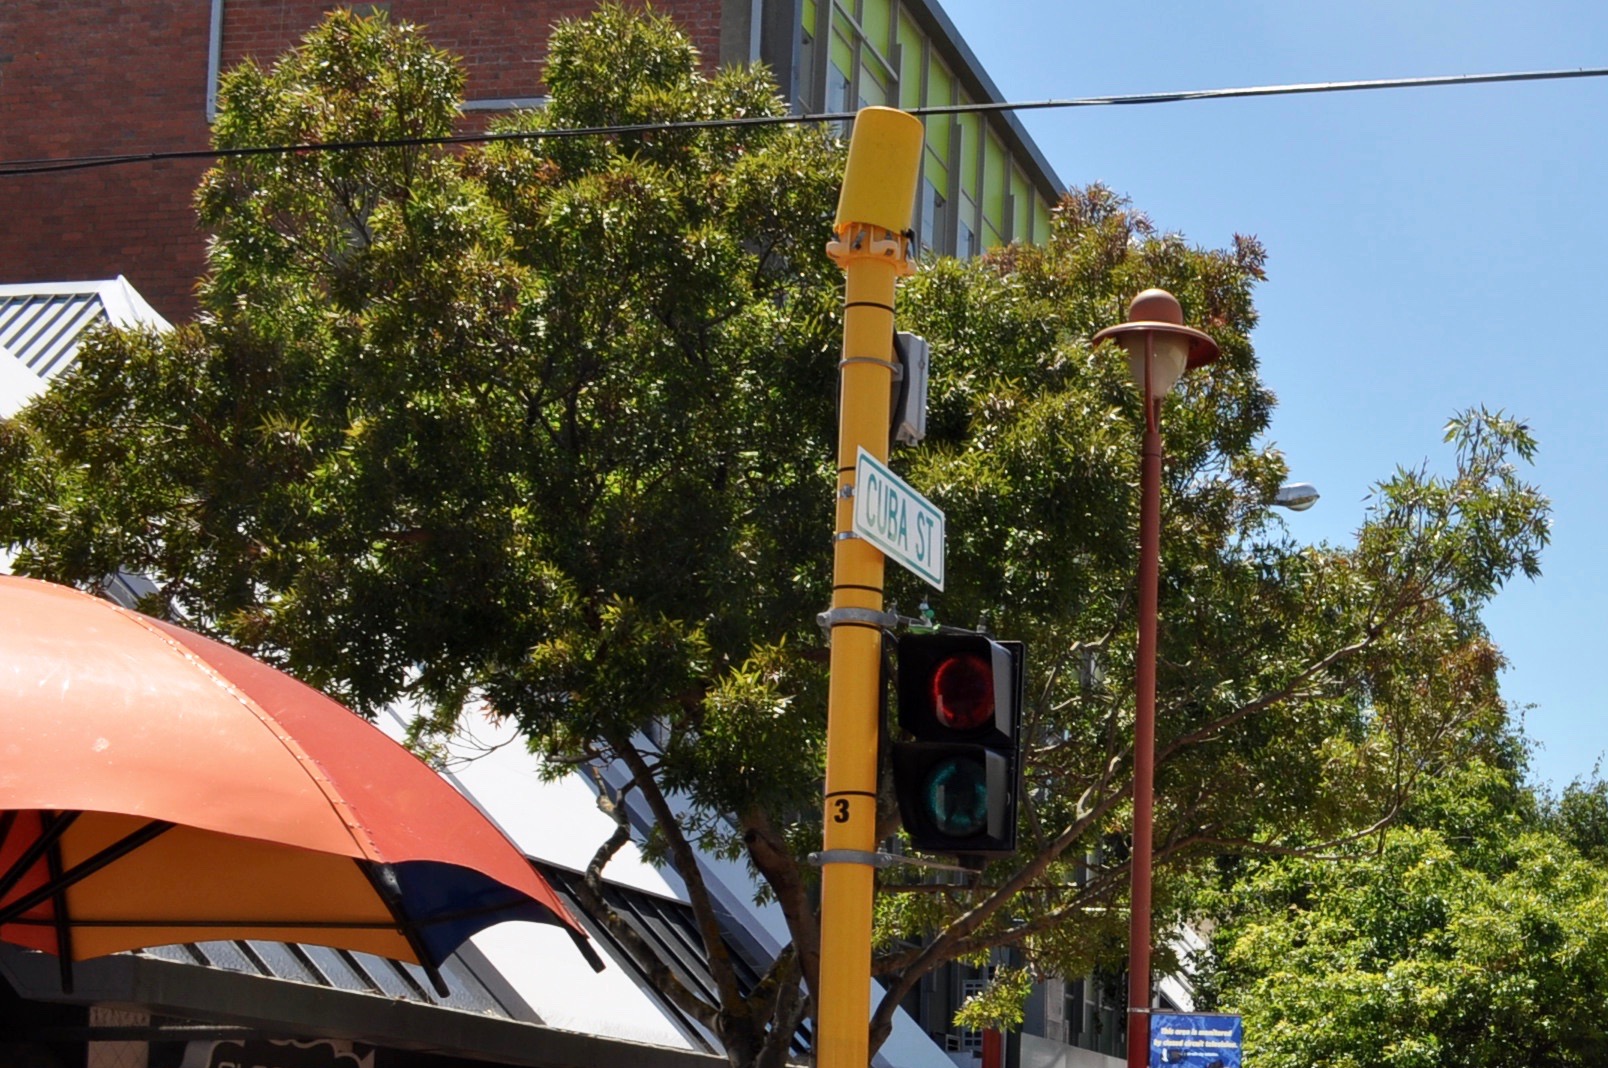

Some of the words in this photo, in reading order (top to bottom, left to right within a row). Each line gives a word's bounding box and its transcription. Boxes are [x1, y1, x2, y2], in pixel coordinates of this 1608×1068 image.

[866, 473, 908, 551] CUBA
[915, 511, 934, 567] ST
[834, 798, 849, 823] 3
